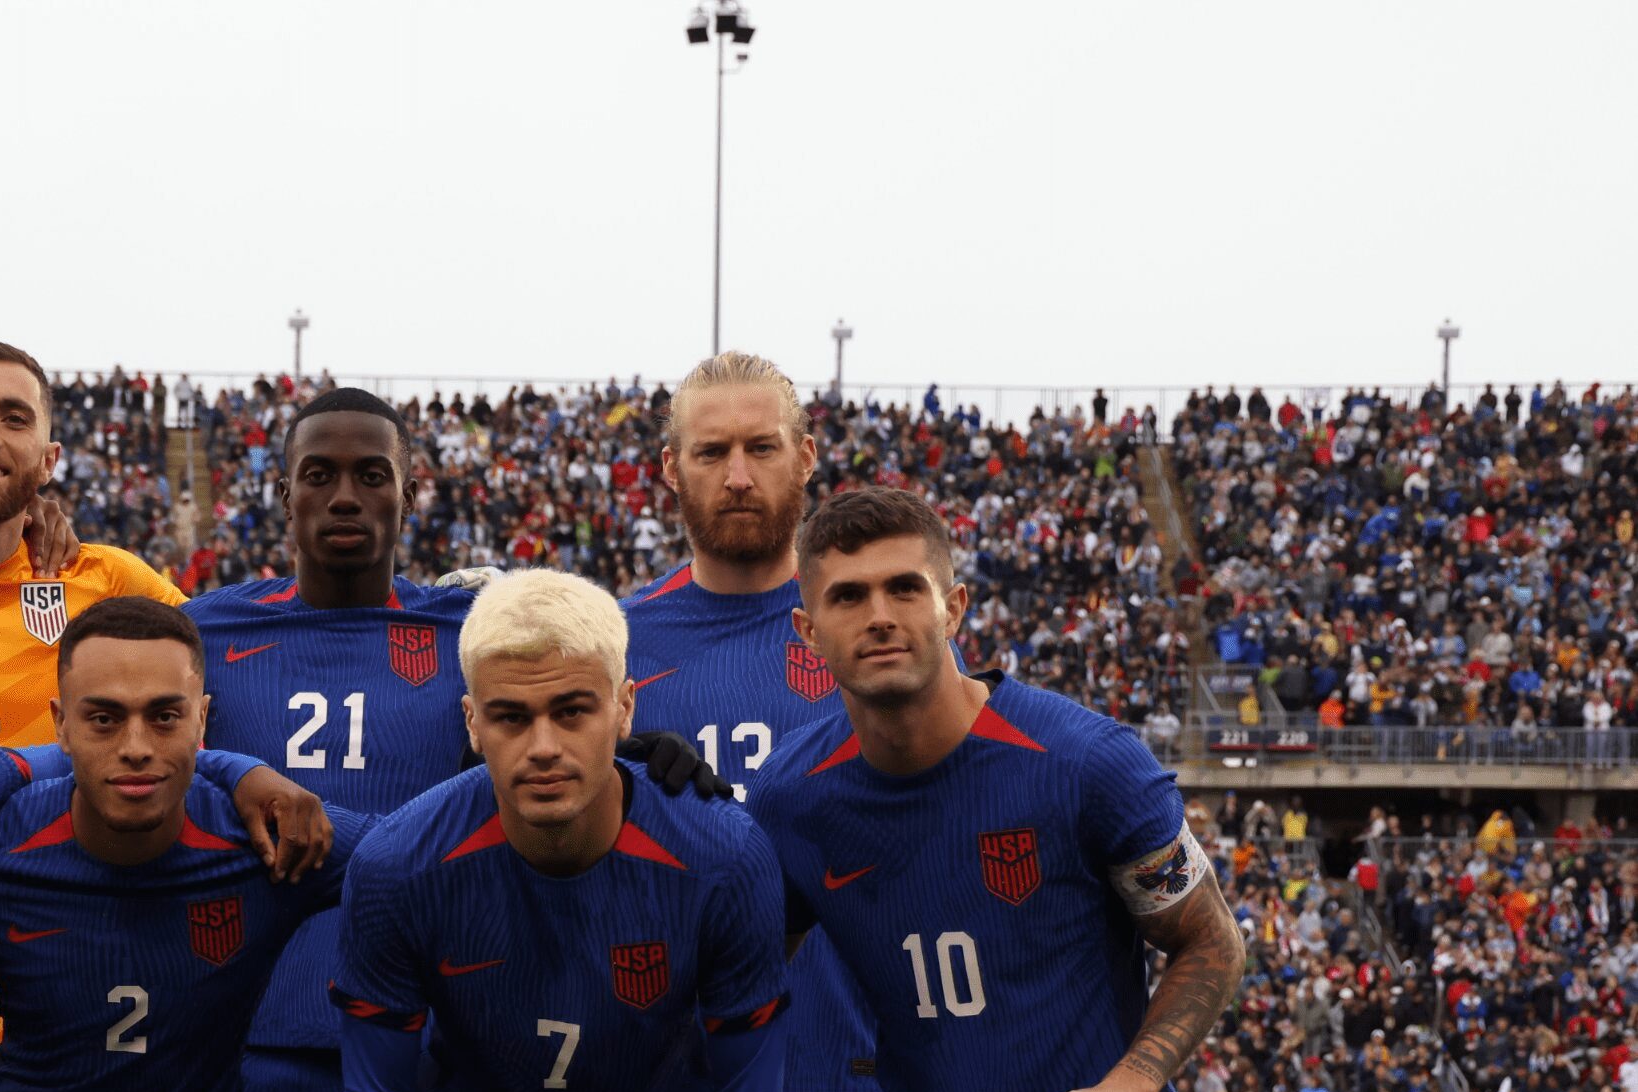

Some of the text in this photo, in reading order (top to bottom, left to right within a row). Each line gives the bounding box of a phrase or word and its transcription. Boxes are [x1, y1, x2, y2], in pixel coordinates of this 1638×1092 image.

[23, 586, 61, 610] USA
[392, 627, 433, 651] USA
[286, 692, 366, 770] 21
[982, 833, 1033, 862] USA
[190, 899, 238, 928] USA
[615, 945, 663, 971] USA
[902, 931, 987, 1018] 10
[106, 985, 149, 1054] 2
[536, 1018, 581, 1090] 7
